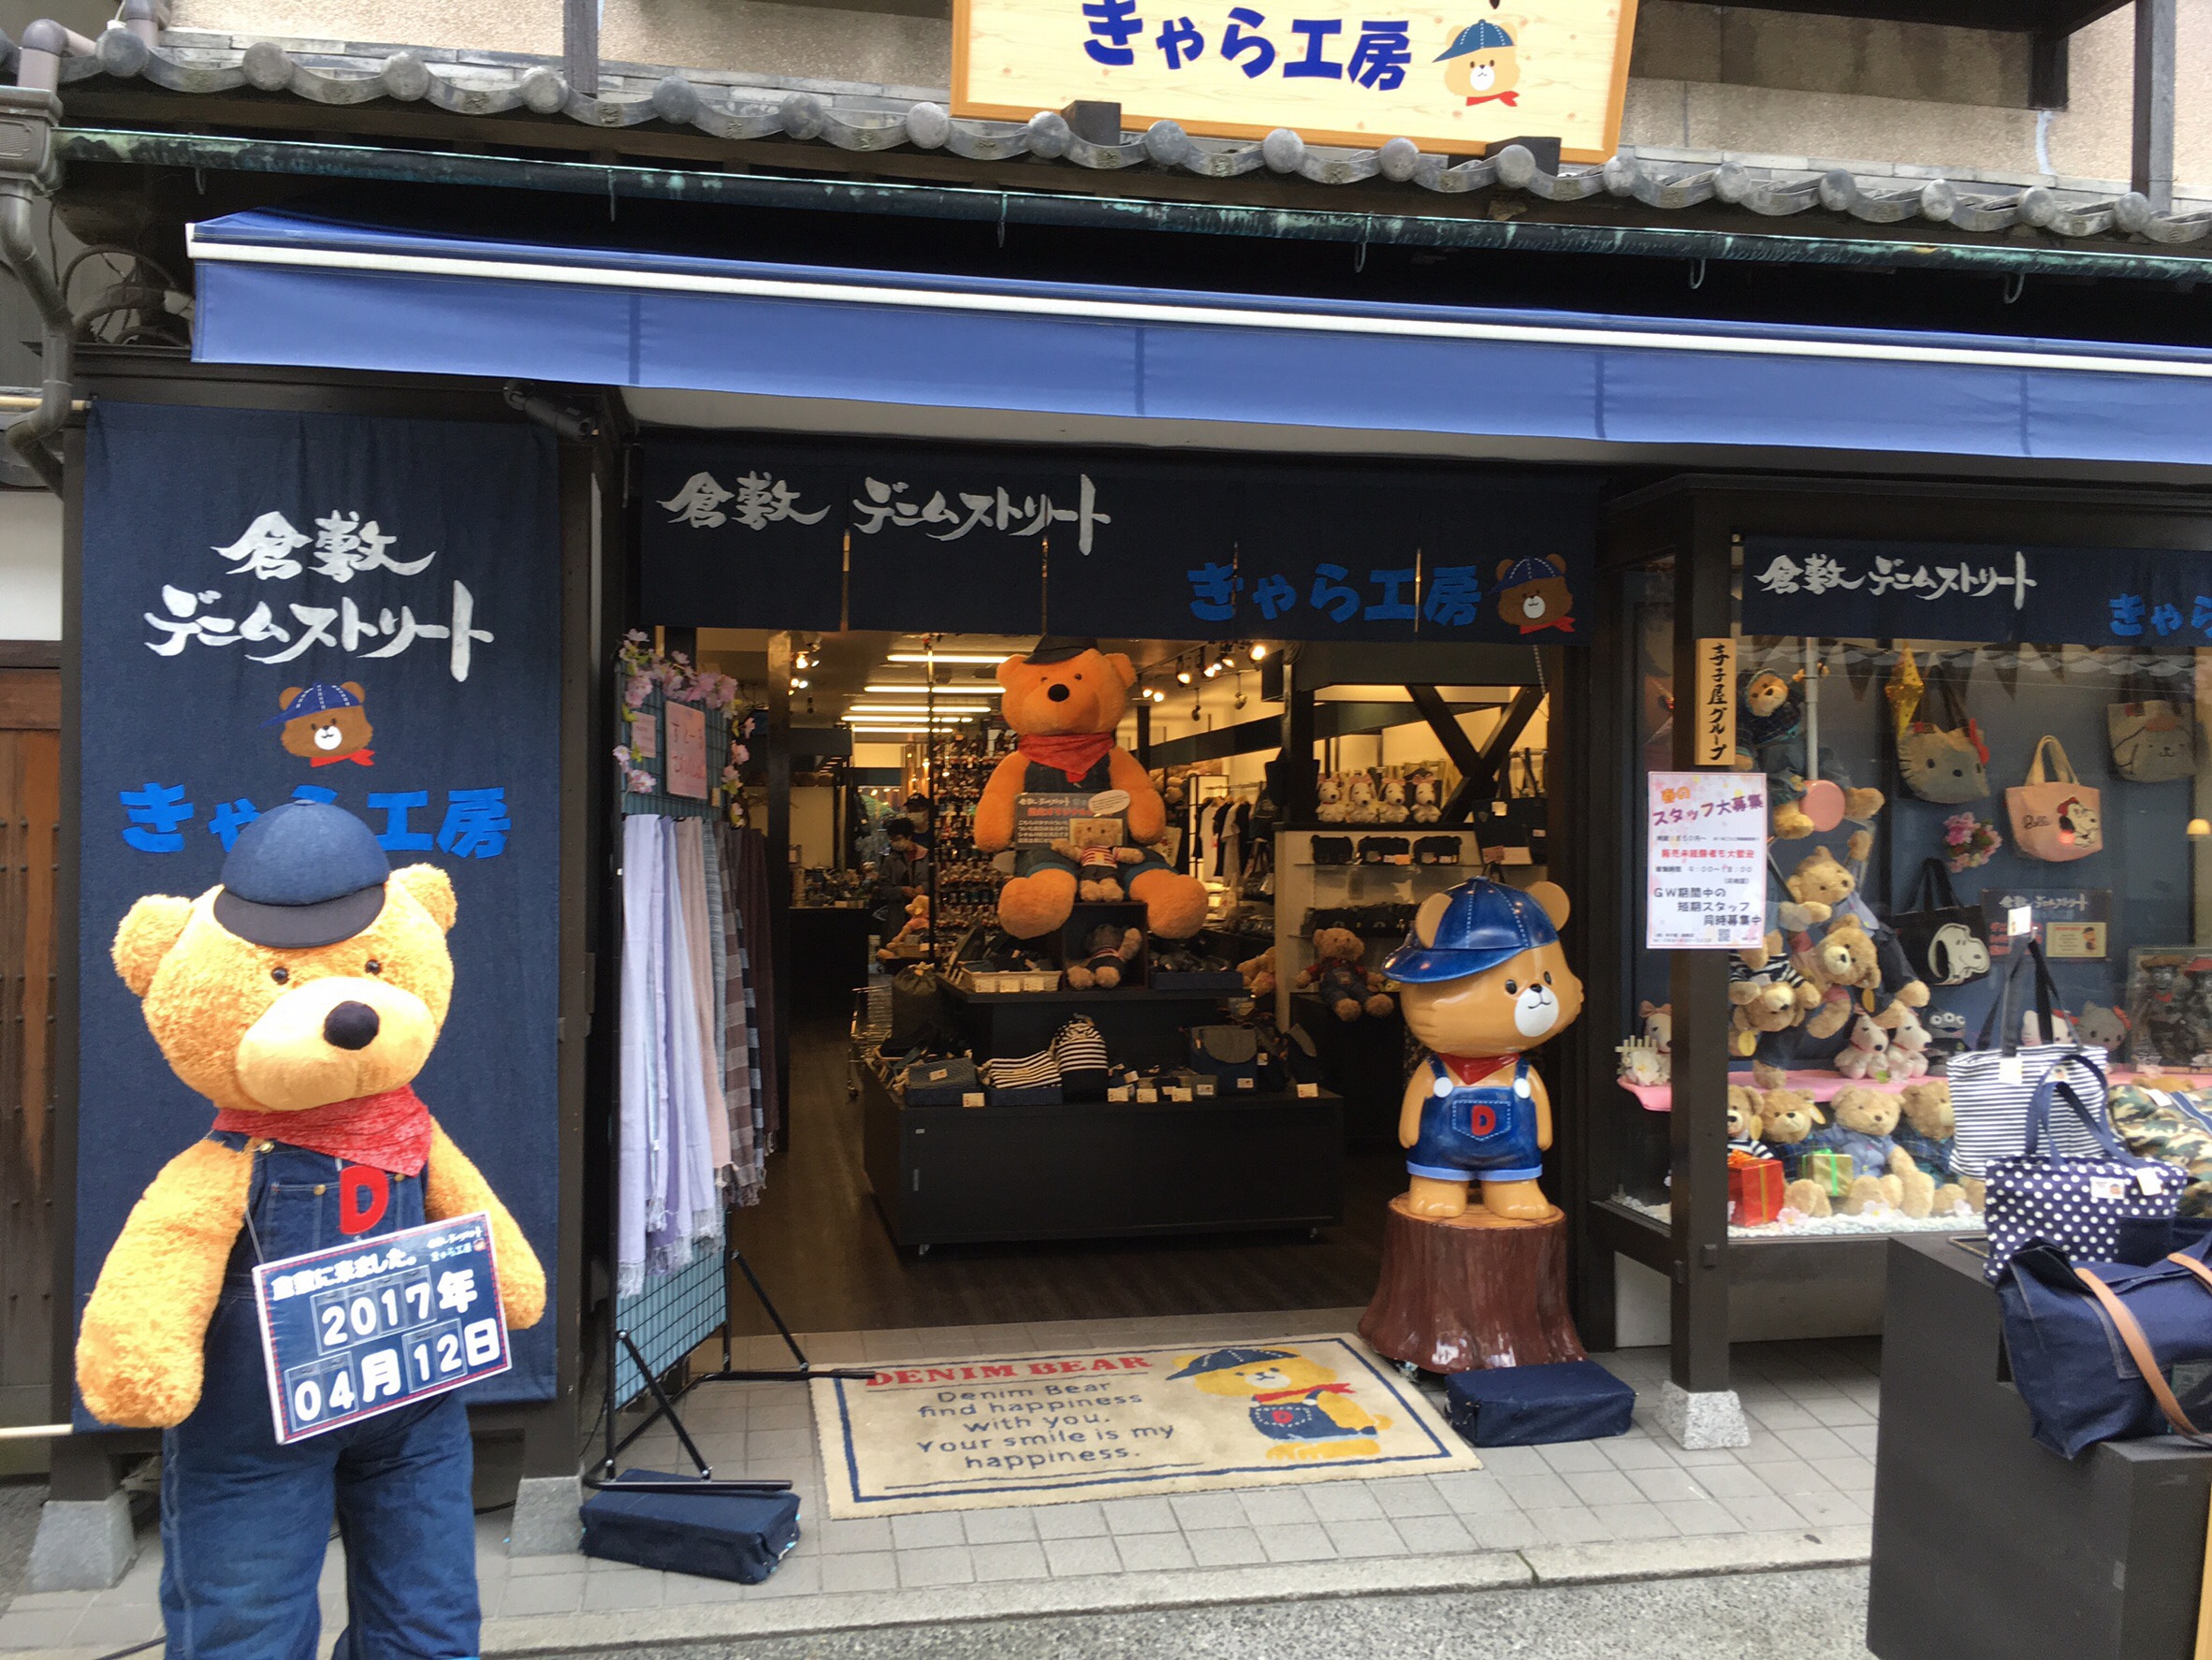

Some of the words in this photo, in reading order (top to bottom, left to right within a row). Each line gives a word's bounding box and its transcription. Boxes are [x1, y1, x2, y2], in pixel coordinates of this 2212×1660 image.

[1082, 0, 1413, 92] きゃら工房
[656, 471, 832, 531] 倉敷
[853, 473, 1112, 557] デニムストリート
[211, 509, 437, 583] 倉敷
[1186, 561, 1482, 627] きゃら工房
[1753, 552, 1865, 595] 倉敷
[1868, 550, 2038, 611] デニムストリート
[143, 579, 494, 683] デニムストリート
[1706, 642, 1730, 761] 寺子屋グループ
[1652, 794, 1764, 826] スタッフ大募集
[1470, 1104, 1496, 1137] D
[339, 1164, 390, 1236] D
[321, 1269, 478, 1347] 2017年
[294, 1318, 501, 1421] 04月12日
[865, 1363, 1018, 1387] DENIM
[1029, 1356, 1153, 1376] BEAR
[937, 1387, 1034, 1404] Denim
[1044, 1381, 1111, 1396] Bear
[917, 1403, 978, 1419] find
[989, 1392, 1143, 1415] happiness
[963, 1416, 1032, 1434] with
[1042, 1414, 1111, 1429] you.
[1003, 1429, 1086, 1448] smile
[1097, 1428, 1120, 1441] is
[1132, 1424, 1175, 1440] my
[964, 1447, 1142, 1470] happiness.
